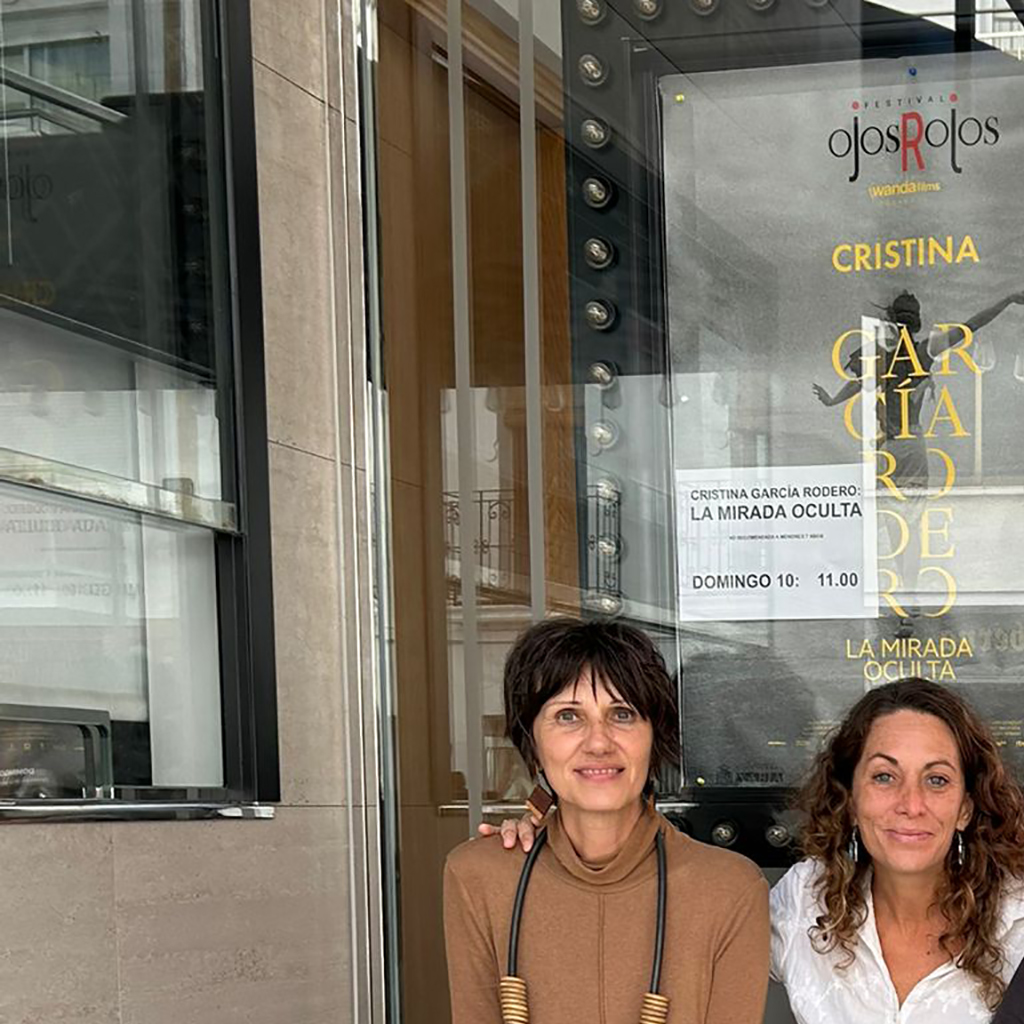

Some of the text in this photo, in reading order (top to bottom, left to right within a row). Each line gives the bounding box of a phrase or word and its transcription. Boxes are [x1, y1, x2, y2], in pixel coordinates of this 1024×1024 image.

[864, 95, 946, 109] FESTIVAL
[831, 235, 980, 273] CRISTINA
[690, 484, 861, 501] CRISTINA GARCÍA RODERO:
[691, 502, 862, 521] LA MIRADA OCULTA
[692, 572, 858, 589] DOMINGO 10: 11.00
[846, 637, 974, 659] LA MIRADA
